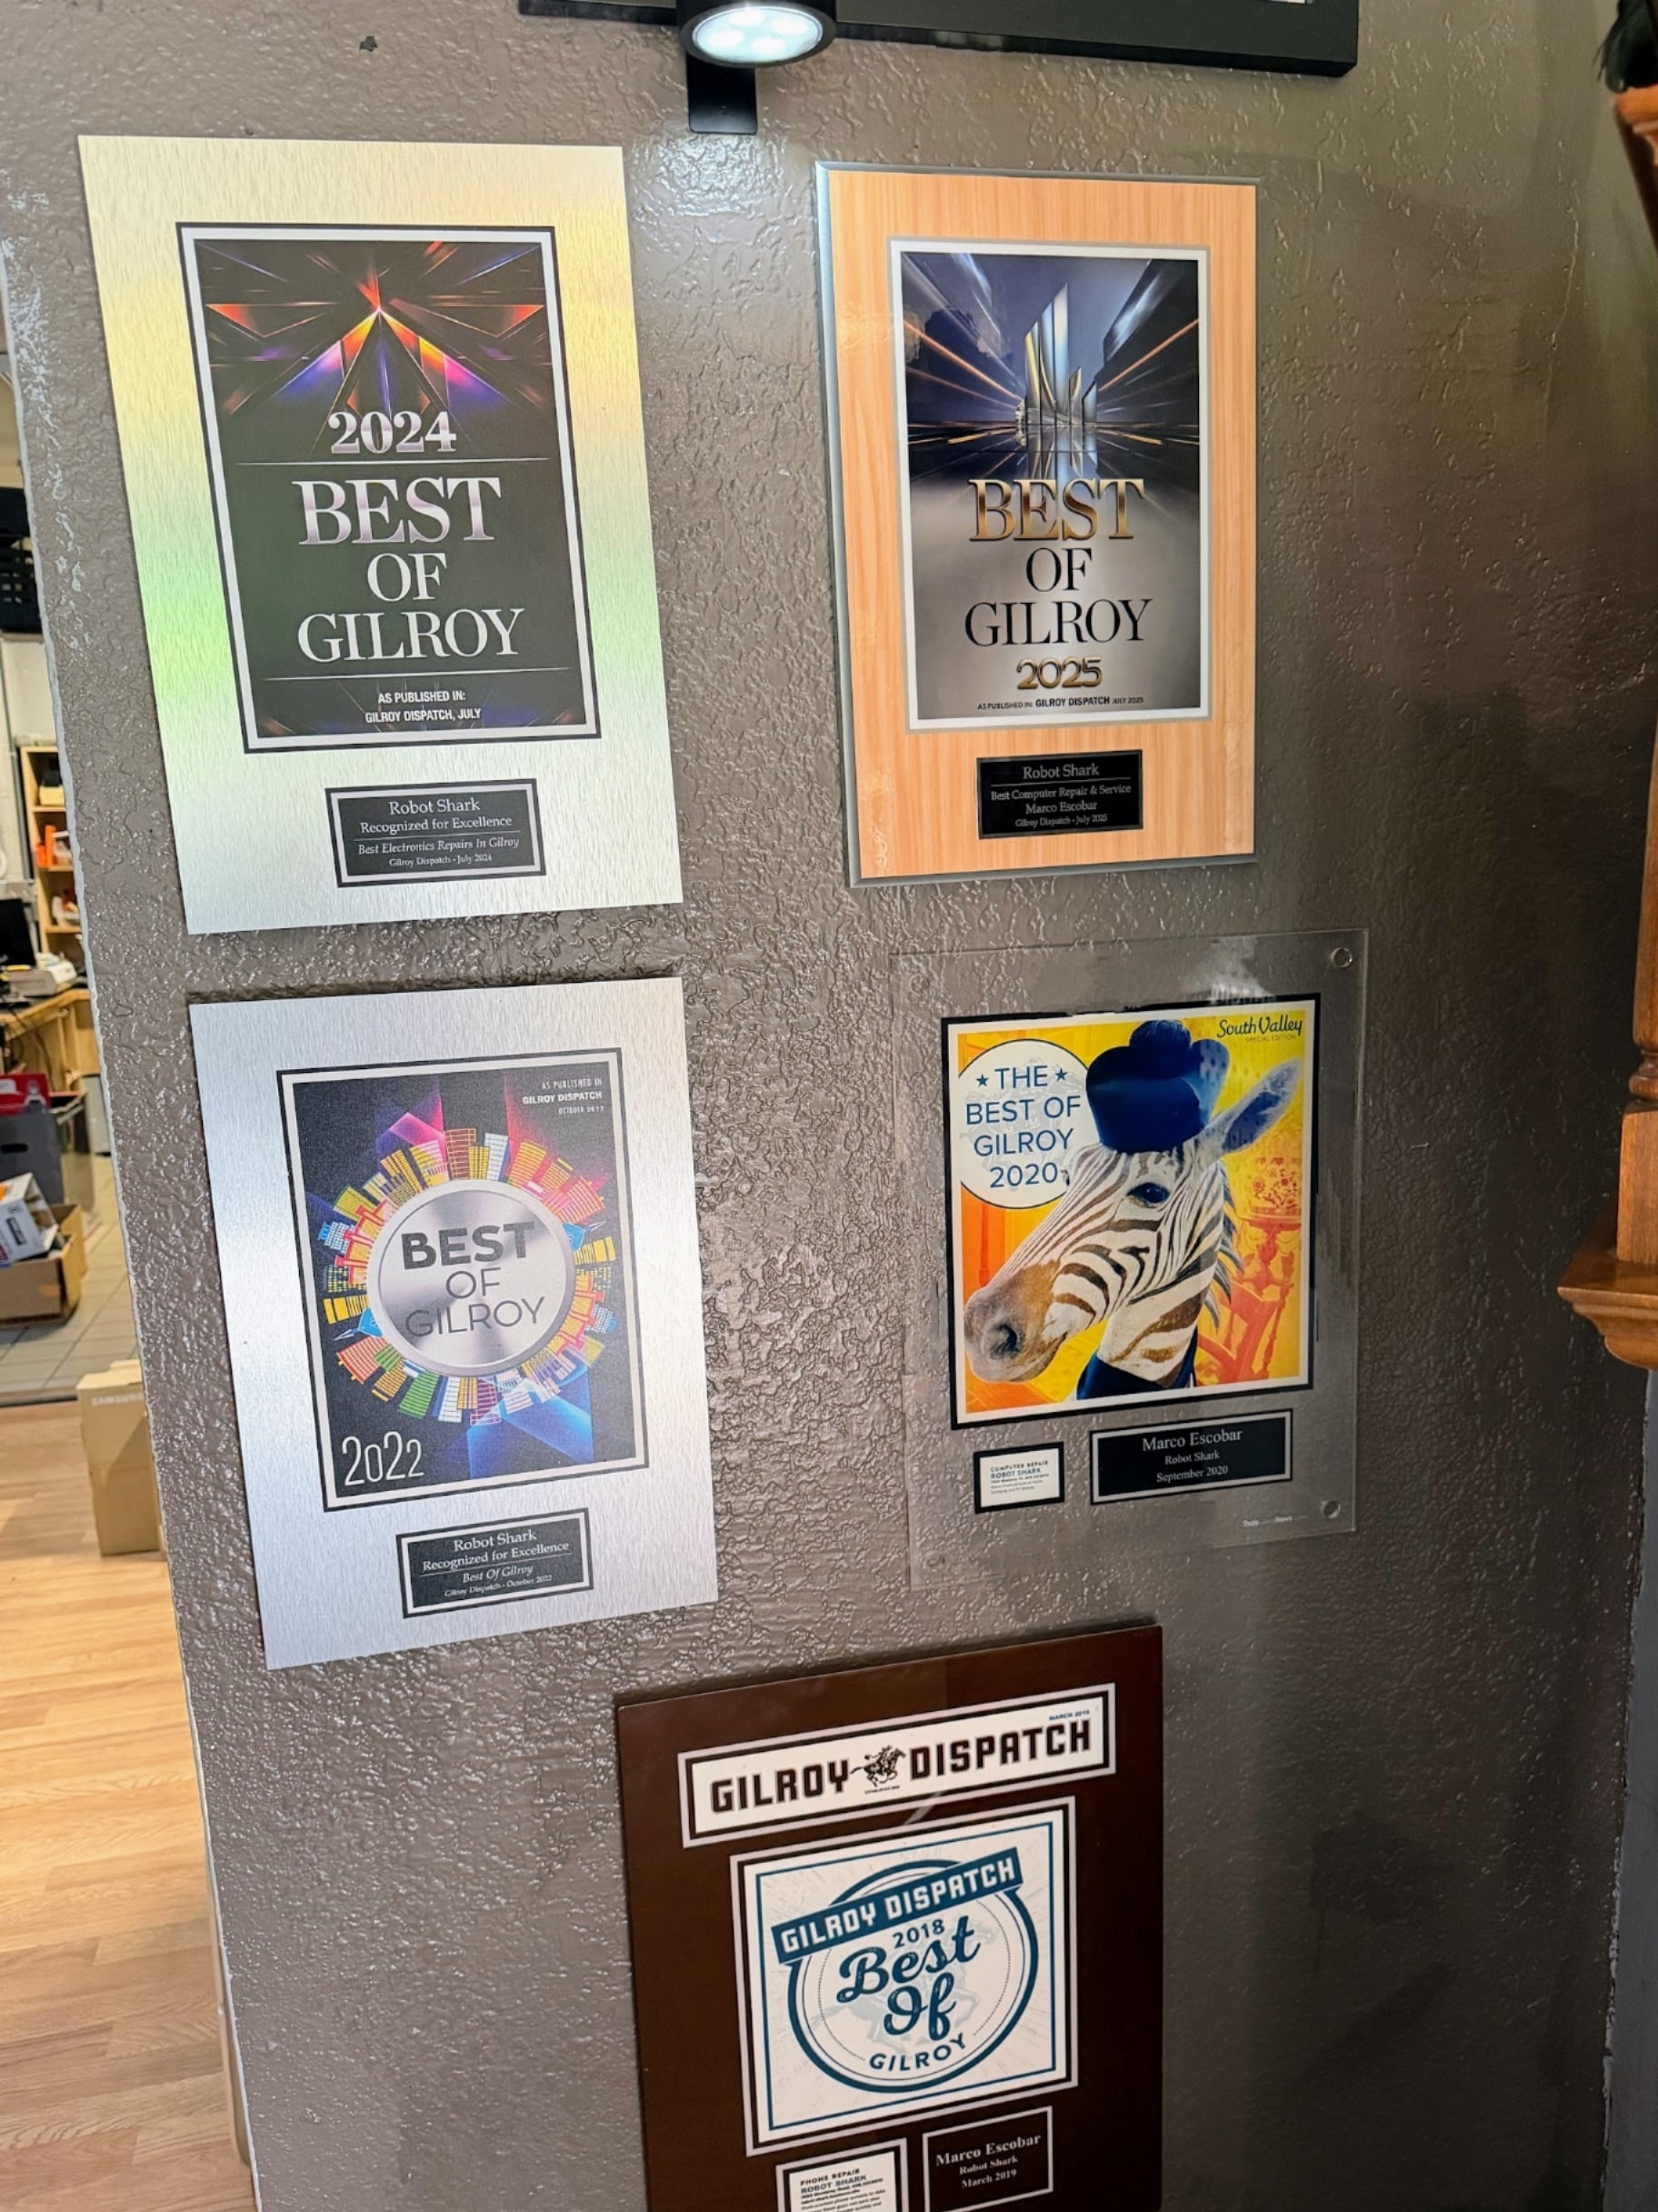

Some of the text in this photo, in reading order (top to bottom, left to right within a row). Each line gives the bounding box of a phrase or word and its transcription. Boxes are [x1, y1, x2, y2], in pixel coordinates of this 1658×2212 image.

[328, 411, 456, 453] 2024
[292, 476, 502, 545] BEST
[968, 478, 1144, 542] BEST
[367, 552, 447, 602] OF
[1025, 547, 1093, 593] OF
[964, 598, 1153, 647] GILROY
[298, 608, 524, 662] GILROY
[1016, 656, 1103, 690] 2025
[378, 690, 465, 704] AS PUBLISHED IN:
[1035, 698, 1066, 707] GILROY
[1069, 696, 1110, 706] DISPATCH
[365, 708, 482, 723] GILROY DISPATCH, JULY
[1023, 763, 1099, 780] Robot Shark
[991, 784, 1132, 801] Best Computer Repair & Service
[389, 797, 481, 816] Robot Shark
[1025, 800, 1098, 815] Marco Escobar
[360, 816, 512, 836] Recognized for Excellence
[1015, 818, 1038, 828] Gilroy
[1040, 816, 1071, 827] Dispatch
[1076, 815, 1091, 825] July
[358, 836, 519, 856] Best Electronics Repairs In Gilroy
[389, 857, 414, 867] Gilroy
[416, 856, 451, 866] Dispatch
[457, 855, 473, 865] July
[474, 854, 492, 862] 2024
[1216, 1014, 1303, 1038] South Valley
[542, 1077, 602, 1090] AS PUBLISHED IN
[994, 1065, 1048, 1090] THE
[523, 1091, 602, 1105] GILROY DISPATCH
[966, 1096, 1082, 1126] BEST OF
[974, 1127, 1074, 1157] GILROY
[989, 1162, 1058, 1188] 2020
[401, 1221, 535, 1270] BEST
[445, 1266, 501, 1299] OF
[405, 1296, 545, 1337] GILROY
[1142, 1428, 1244, 1452] Marco Escobar
[341, 1430, 424, 1486] 2022
[991, 1460, 1048, 1472] COMPUTER REPAIR
[1164, 1450, 1221, 1466] Robot Shark
[991, 1467, 1042, 1479] ROBOT SHARK
[1156, 1465, 1229, 1484] September 2020
[454, 1529, 538, 1552] Robot Shark
[423, 1543, 569, 1571] Recognized for Excellence
[463, 1565, 534, 1583] Best Of Gilroy
[444, 1589, 467, 1597] Gilroy
[469, 1583, 502, 1594] Dispatch
[506, 1577, 534, 1588] October
[1049, 1712, 1074, 1720] MARCH
[710, 1718, 1091, 1814] GILROY DISPATCH
[780, 1857, 1016, 1954] GILROY DISPATCH
[893, 1918, 945, 1949] 2018
[835, 1915, 981, 2004] Best
[884, 1972, 957, 2041] Of
[869, 2033, 966, 2072] GILROY
[935, 2135, 1042, 2167] Marco Escobar
[800, 2168, 860, 2186] PHONE REPAIR
[959, 2156, 1018, 2175] Robot Shark
[801, 2175, 867, 2194] ROBOT SHARK
[961, 2168, 1017, 2188] March 2019
